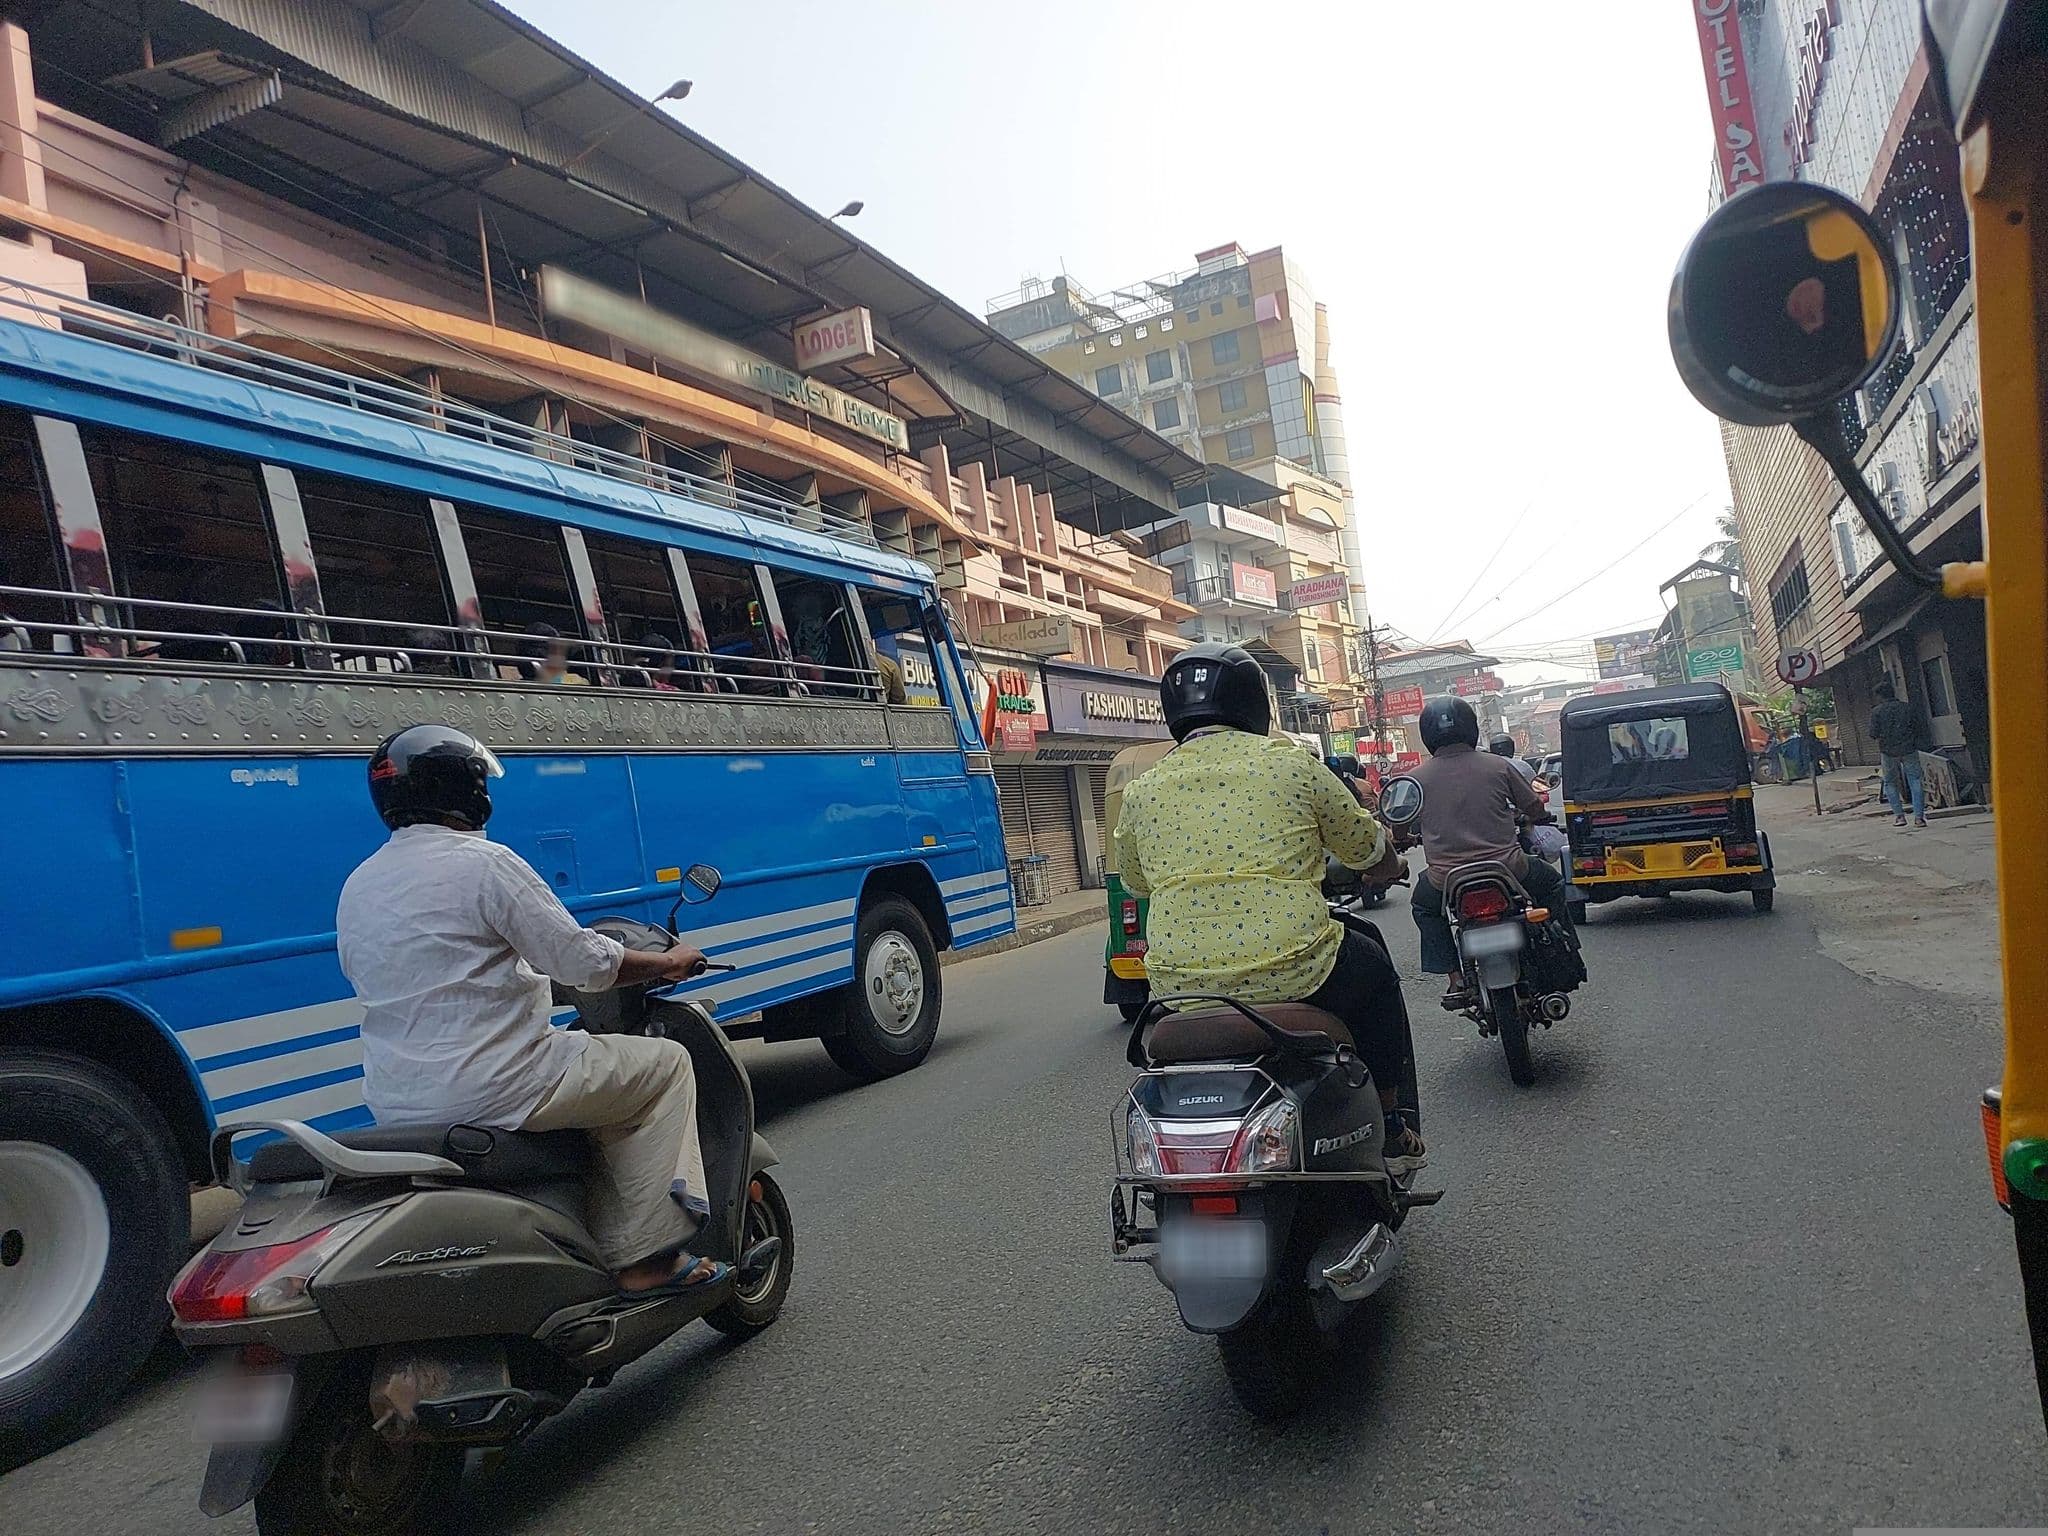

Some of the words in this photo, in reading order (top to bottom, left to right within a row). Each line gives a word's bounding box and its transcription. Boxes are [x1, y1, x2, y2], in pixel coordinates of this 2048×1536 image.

[799, 318, 857, 358] LODGE
[738, 359, 833, 413] OURIST
[843, 399, 901, 441] HOME
[1293, 577, 1344, 596] ARADHANA
[1298, 588, 1341, 603] FURNISHINGS
[998, 694, 1036, 712] TRAVELS
[1083, 691, 1135, 719] FASHION
[1035, 748, 1078, 761] FASHION
[1178, 1095, 1224, 1107] SUZUKI
[375, 1245, 488, 1268] Activa
